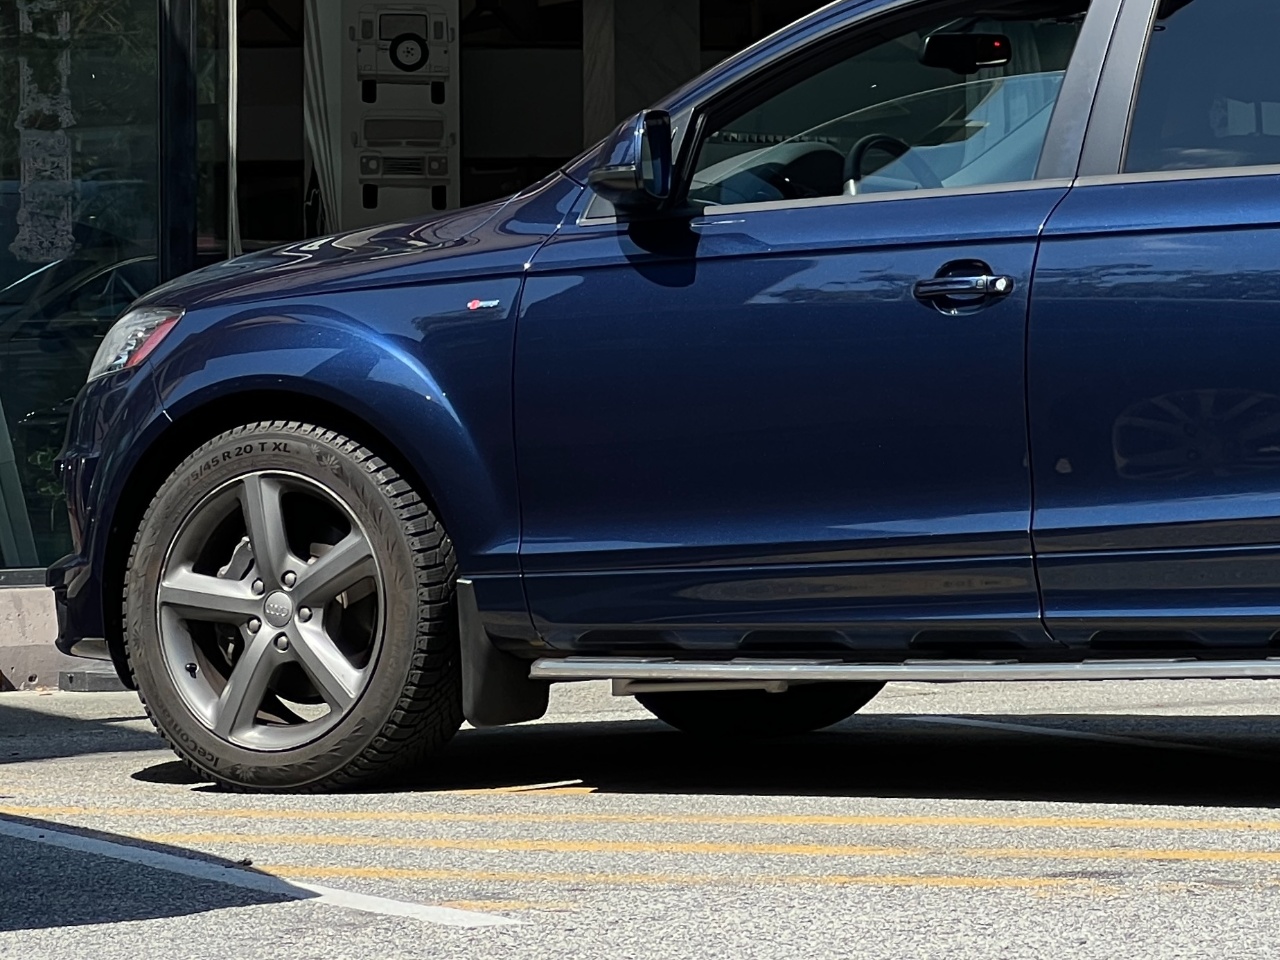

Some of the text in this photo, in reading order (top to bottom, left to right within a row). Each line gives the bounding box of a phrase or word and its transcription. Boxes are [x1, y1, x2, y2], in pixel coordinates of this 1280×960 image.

[180, 441, 291, 489] 75/45 R 20 T XL
